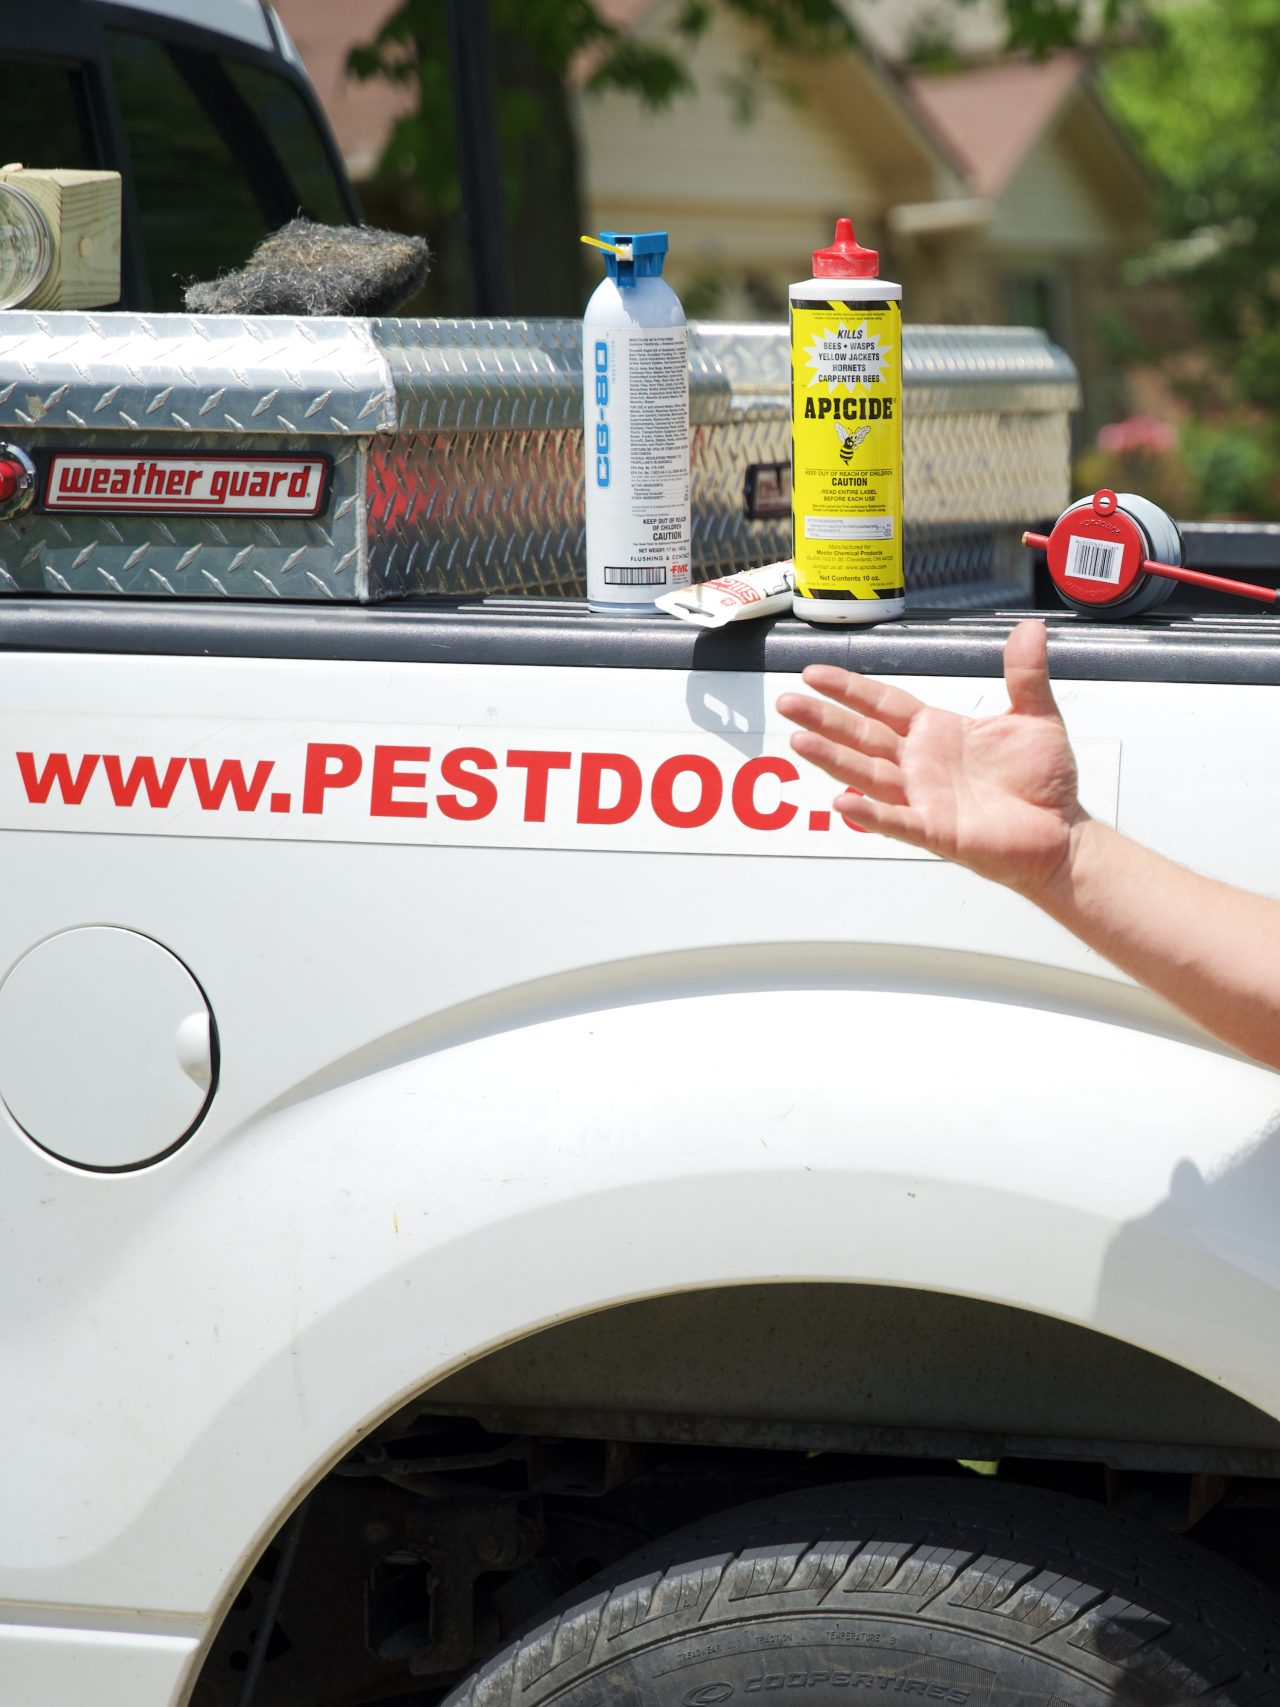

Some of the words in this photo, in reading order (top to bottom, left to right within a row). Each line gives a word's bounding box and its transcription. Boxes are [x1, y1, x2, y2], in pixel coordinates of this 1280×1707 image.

[837, 330, 863, 339] KILLS
[824, 342, 841, 350] BEES
[850, 342, 875, 350] WASPS
[804, 397, 893, 420] APICIDE
[595, 341, 609, 487] CB-80
[59, 462, 203, 495] weather
[210, 465, 312, 503] guard
[831, 477, 868, 486] CAUTION
[652, 531, 682, 540] CAUTION
[671, 564, 688, 574] FMC
[825, 1631, 881, 1642] TEMPERATURE
